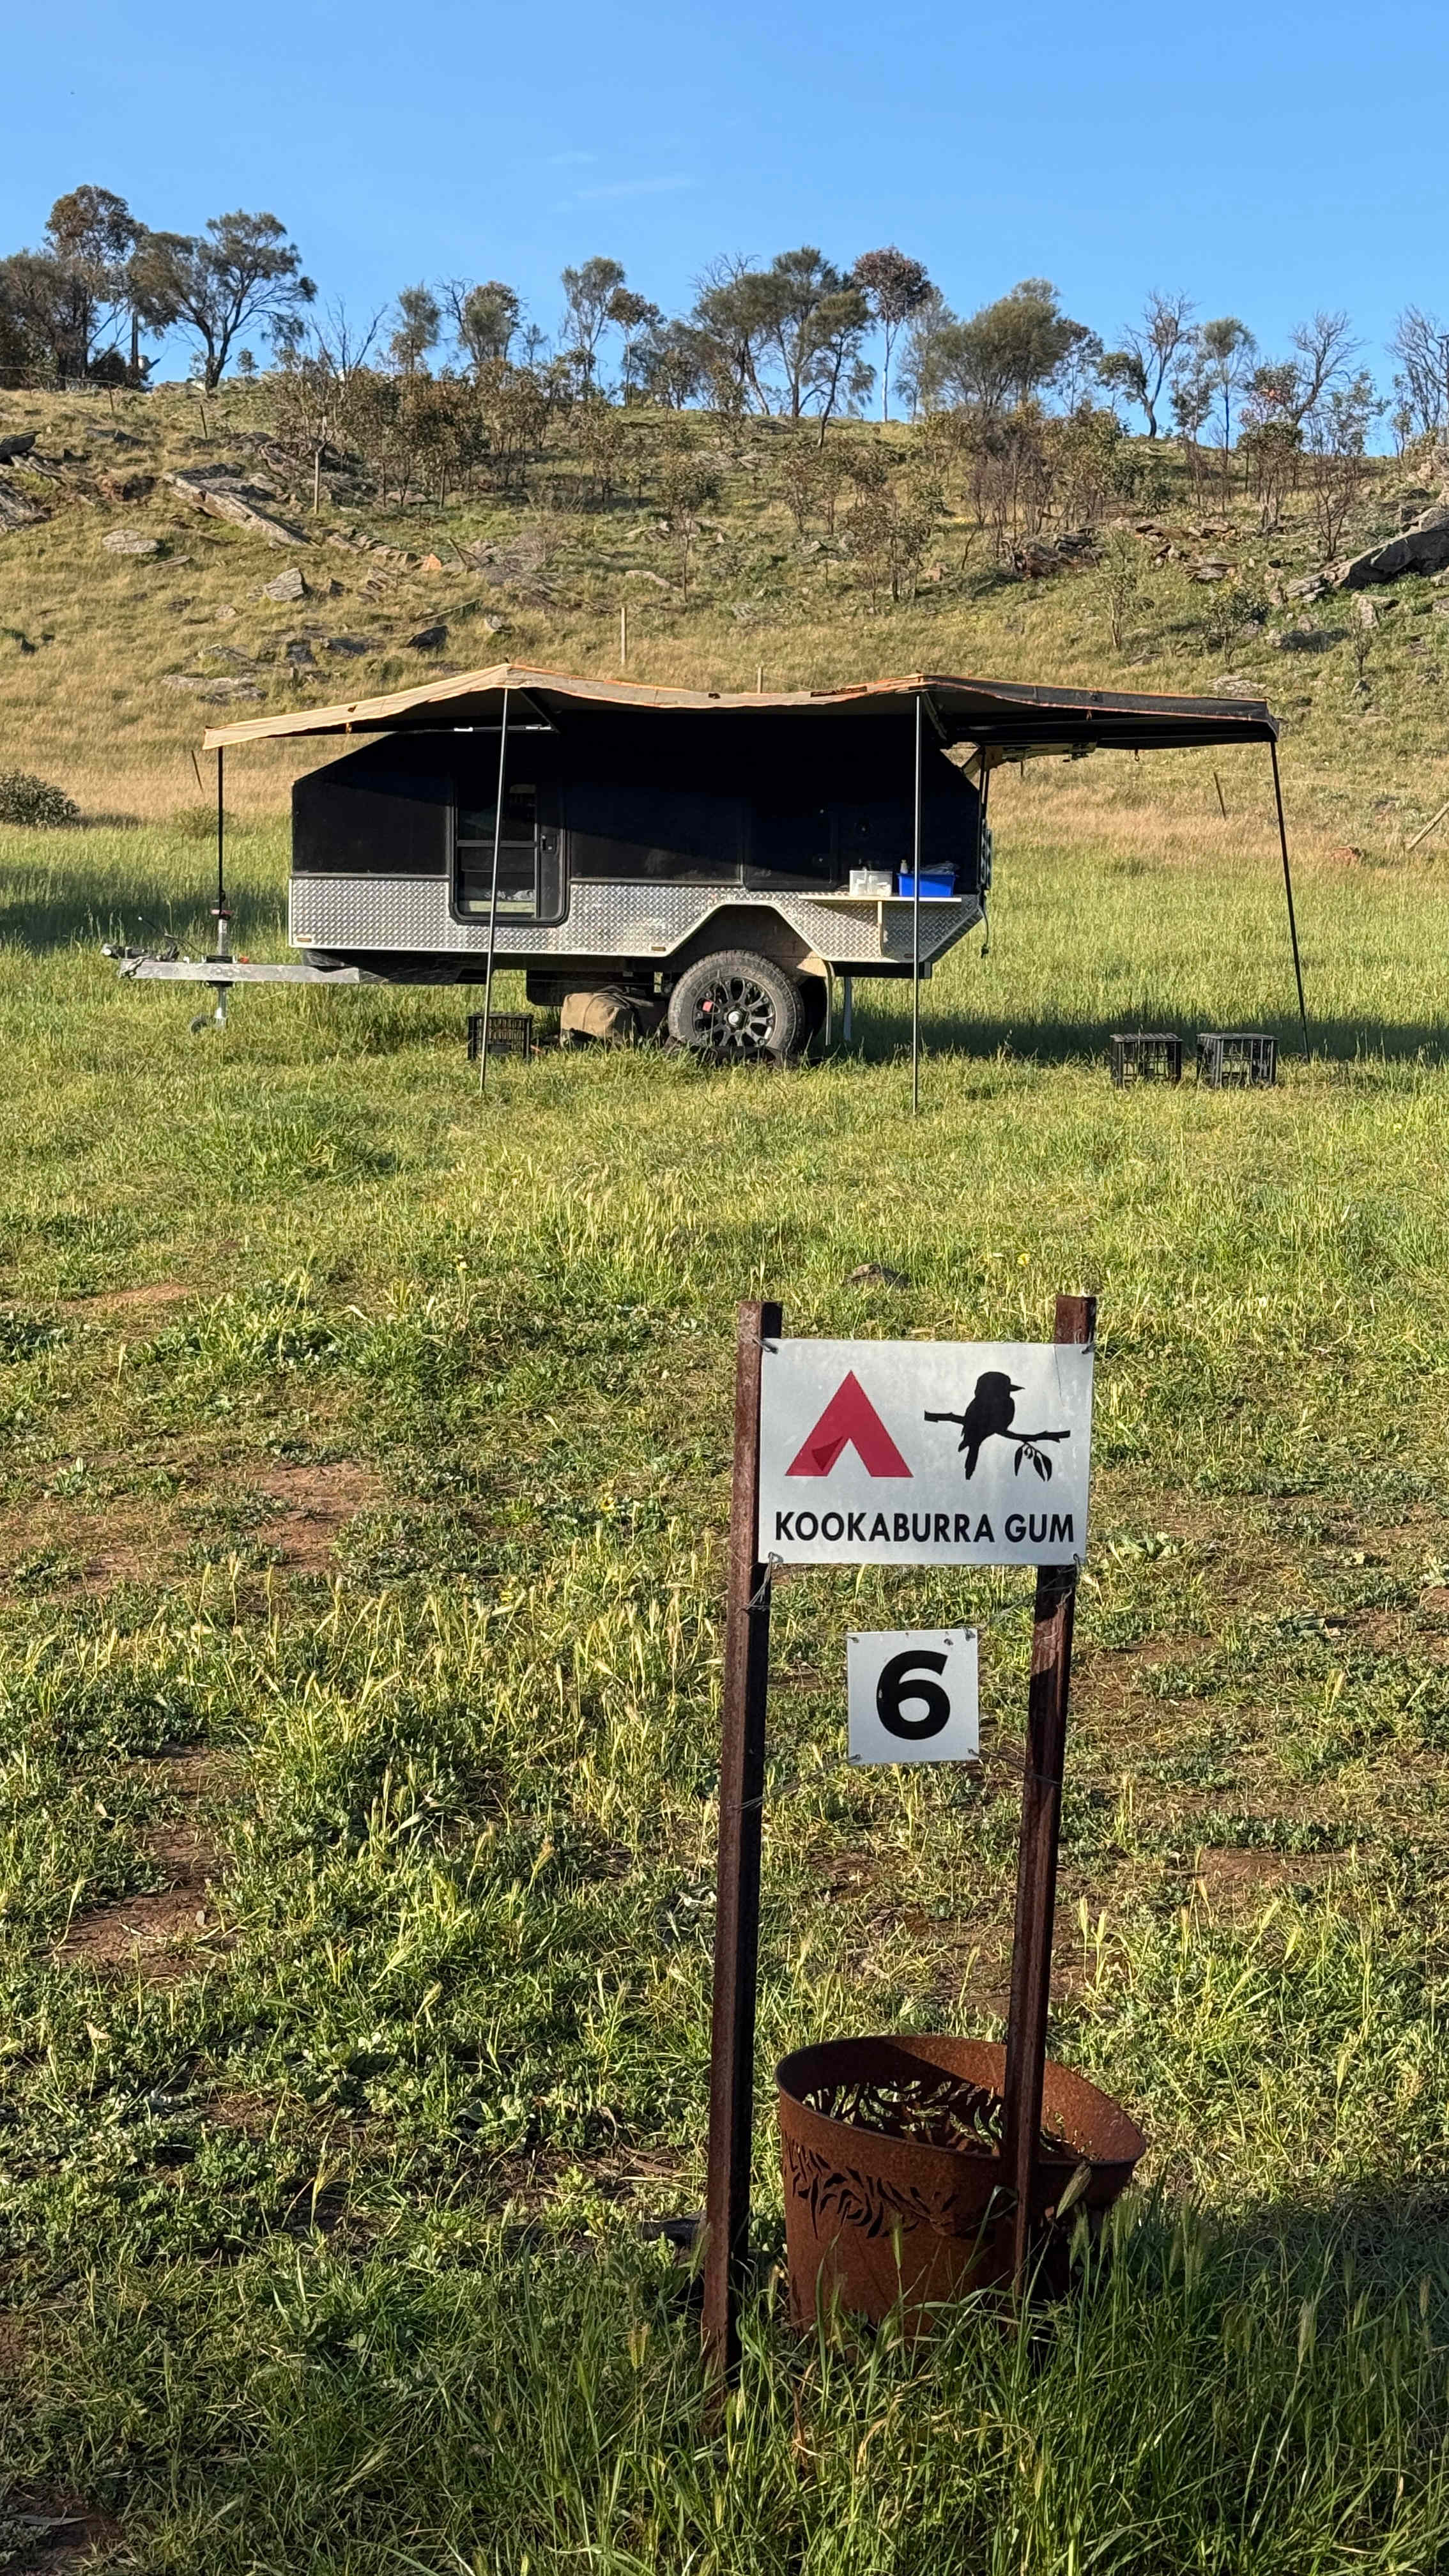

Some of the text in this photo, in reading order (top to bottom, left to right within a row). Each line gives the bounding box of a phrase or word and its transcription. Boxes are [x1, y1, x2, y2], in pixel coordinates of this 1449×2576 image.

[776, 1511, 1074, 1543] KOOKABURRA GUM
[876, 1650, 951, 1741] 6
